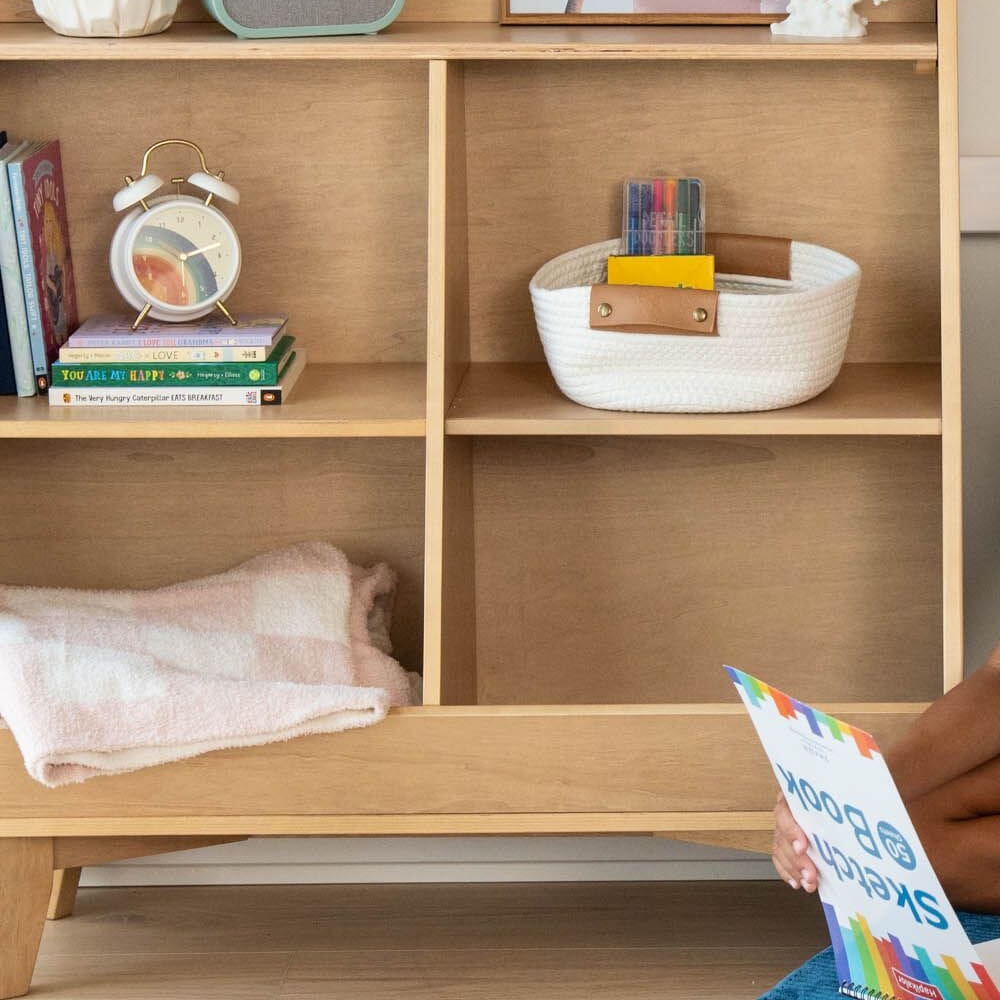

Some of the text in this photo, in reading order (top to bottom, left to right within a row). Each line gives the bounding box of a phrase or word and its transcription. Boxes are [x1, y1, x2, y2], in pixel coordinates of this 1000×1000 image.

[144, 339, 160, 348] LOVE
[152, 351, 179, 359] LOVE
[61, 370, 84, 380] YOU
[85, 370, 107, 380] ARE
[110, 370, 126, 380] MY
[130, 369, 164, 381] HAPPY
[89, 394, 104, 403] Very
[105, 394, 131, 403] Hungry
[132, 394, 170, 403] Caterpillar
[776, 762, 882, 860] Book
[885, 838, 911, 863] 50
[813, 832, 949, 930] Sketch
